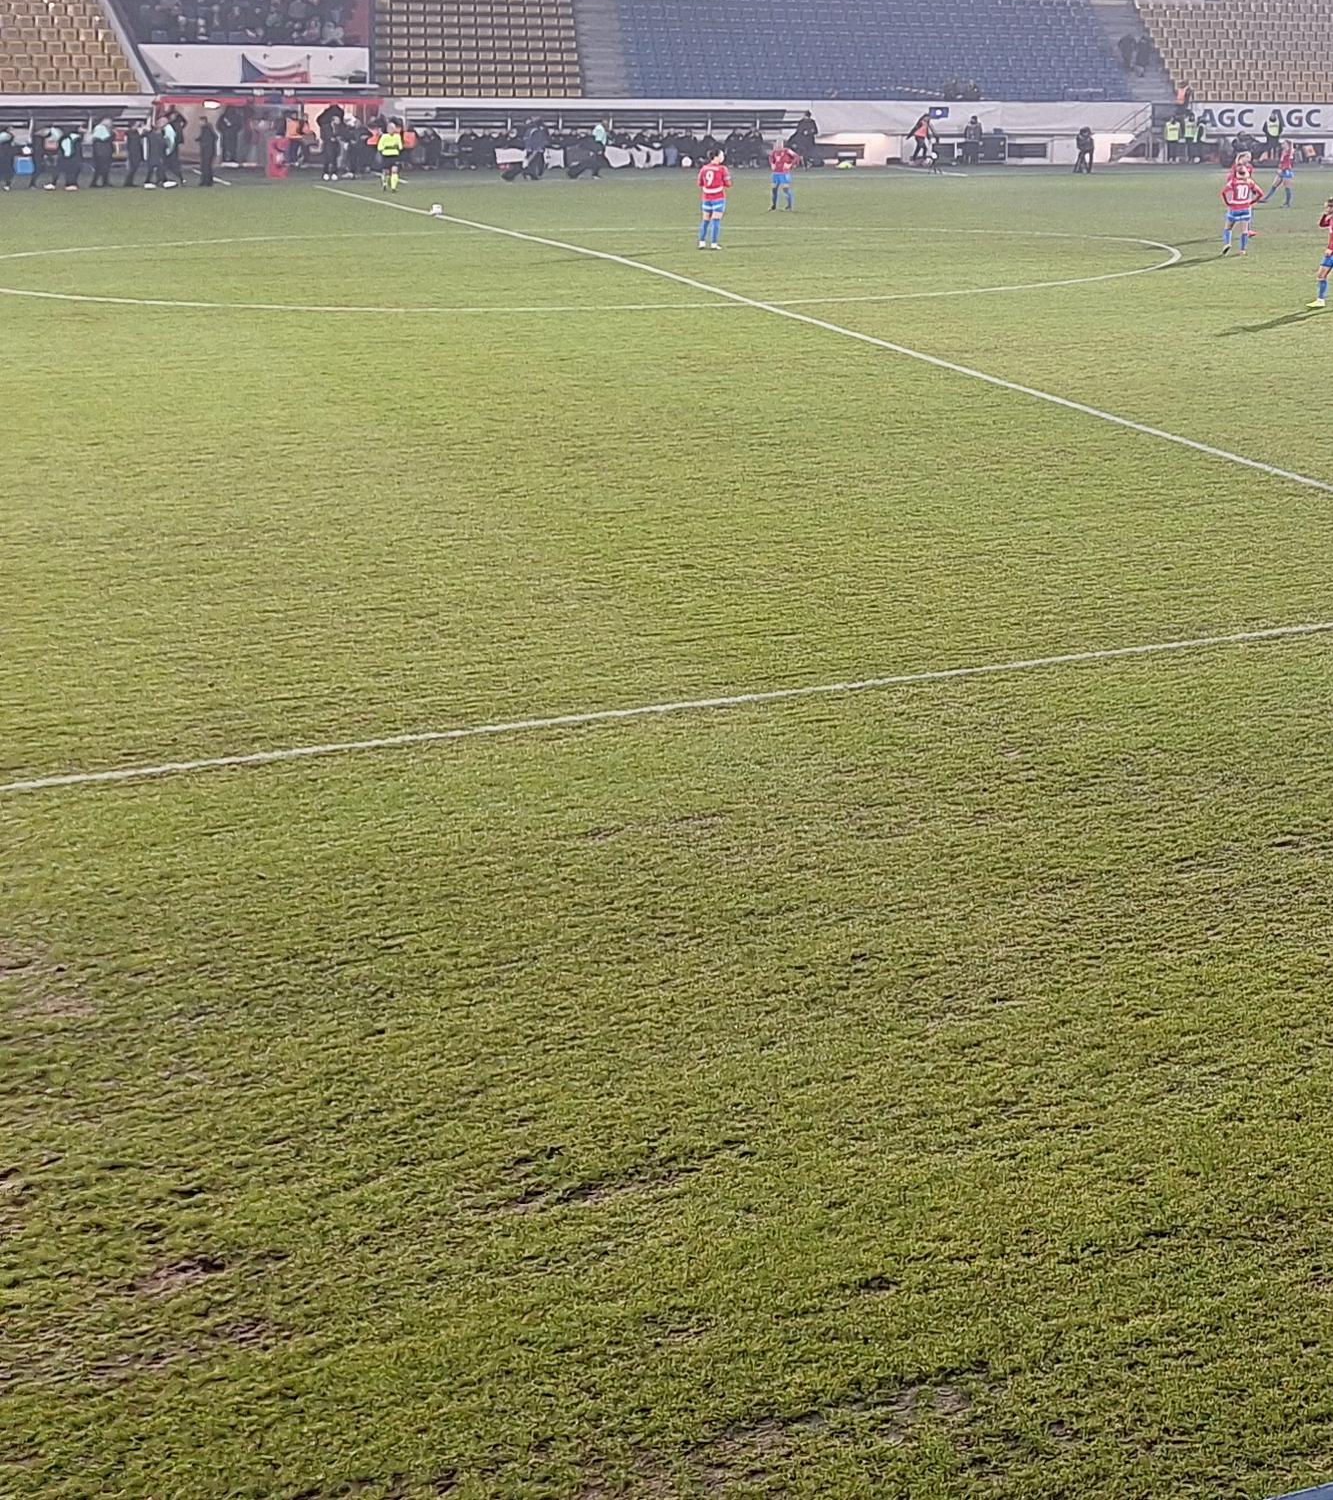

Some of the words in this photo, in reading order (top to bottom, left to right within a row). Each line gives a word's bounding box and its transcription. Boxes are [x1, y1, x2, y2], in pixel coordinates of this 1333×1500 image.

[1200, 109, 1254, 128] AGC
[705, 170, 714, 186] 9
[1236, 184, 1249, 200] 10
